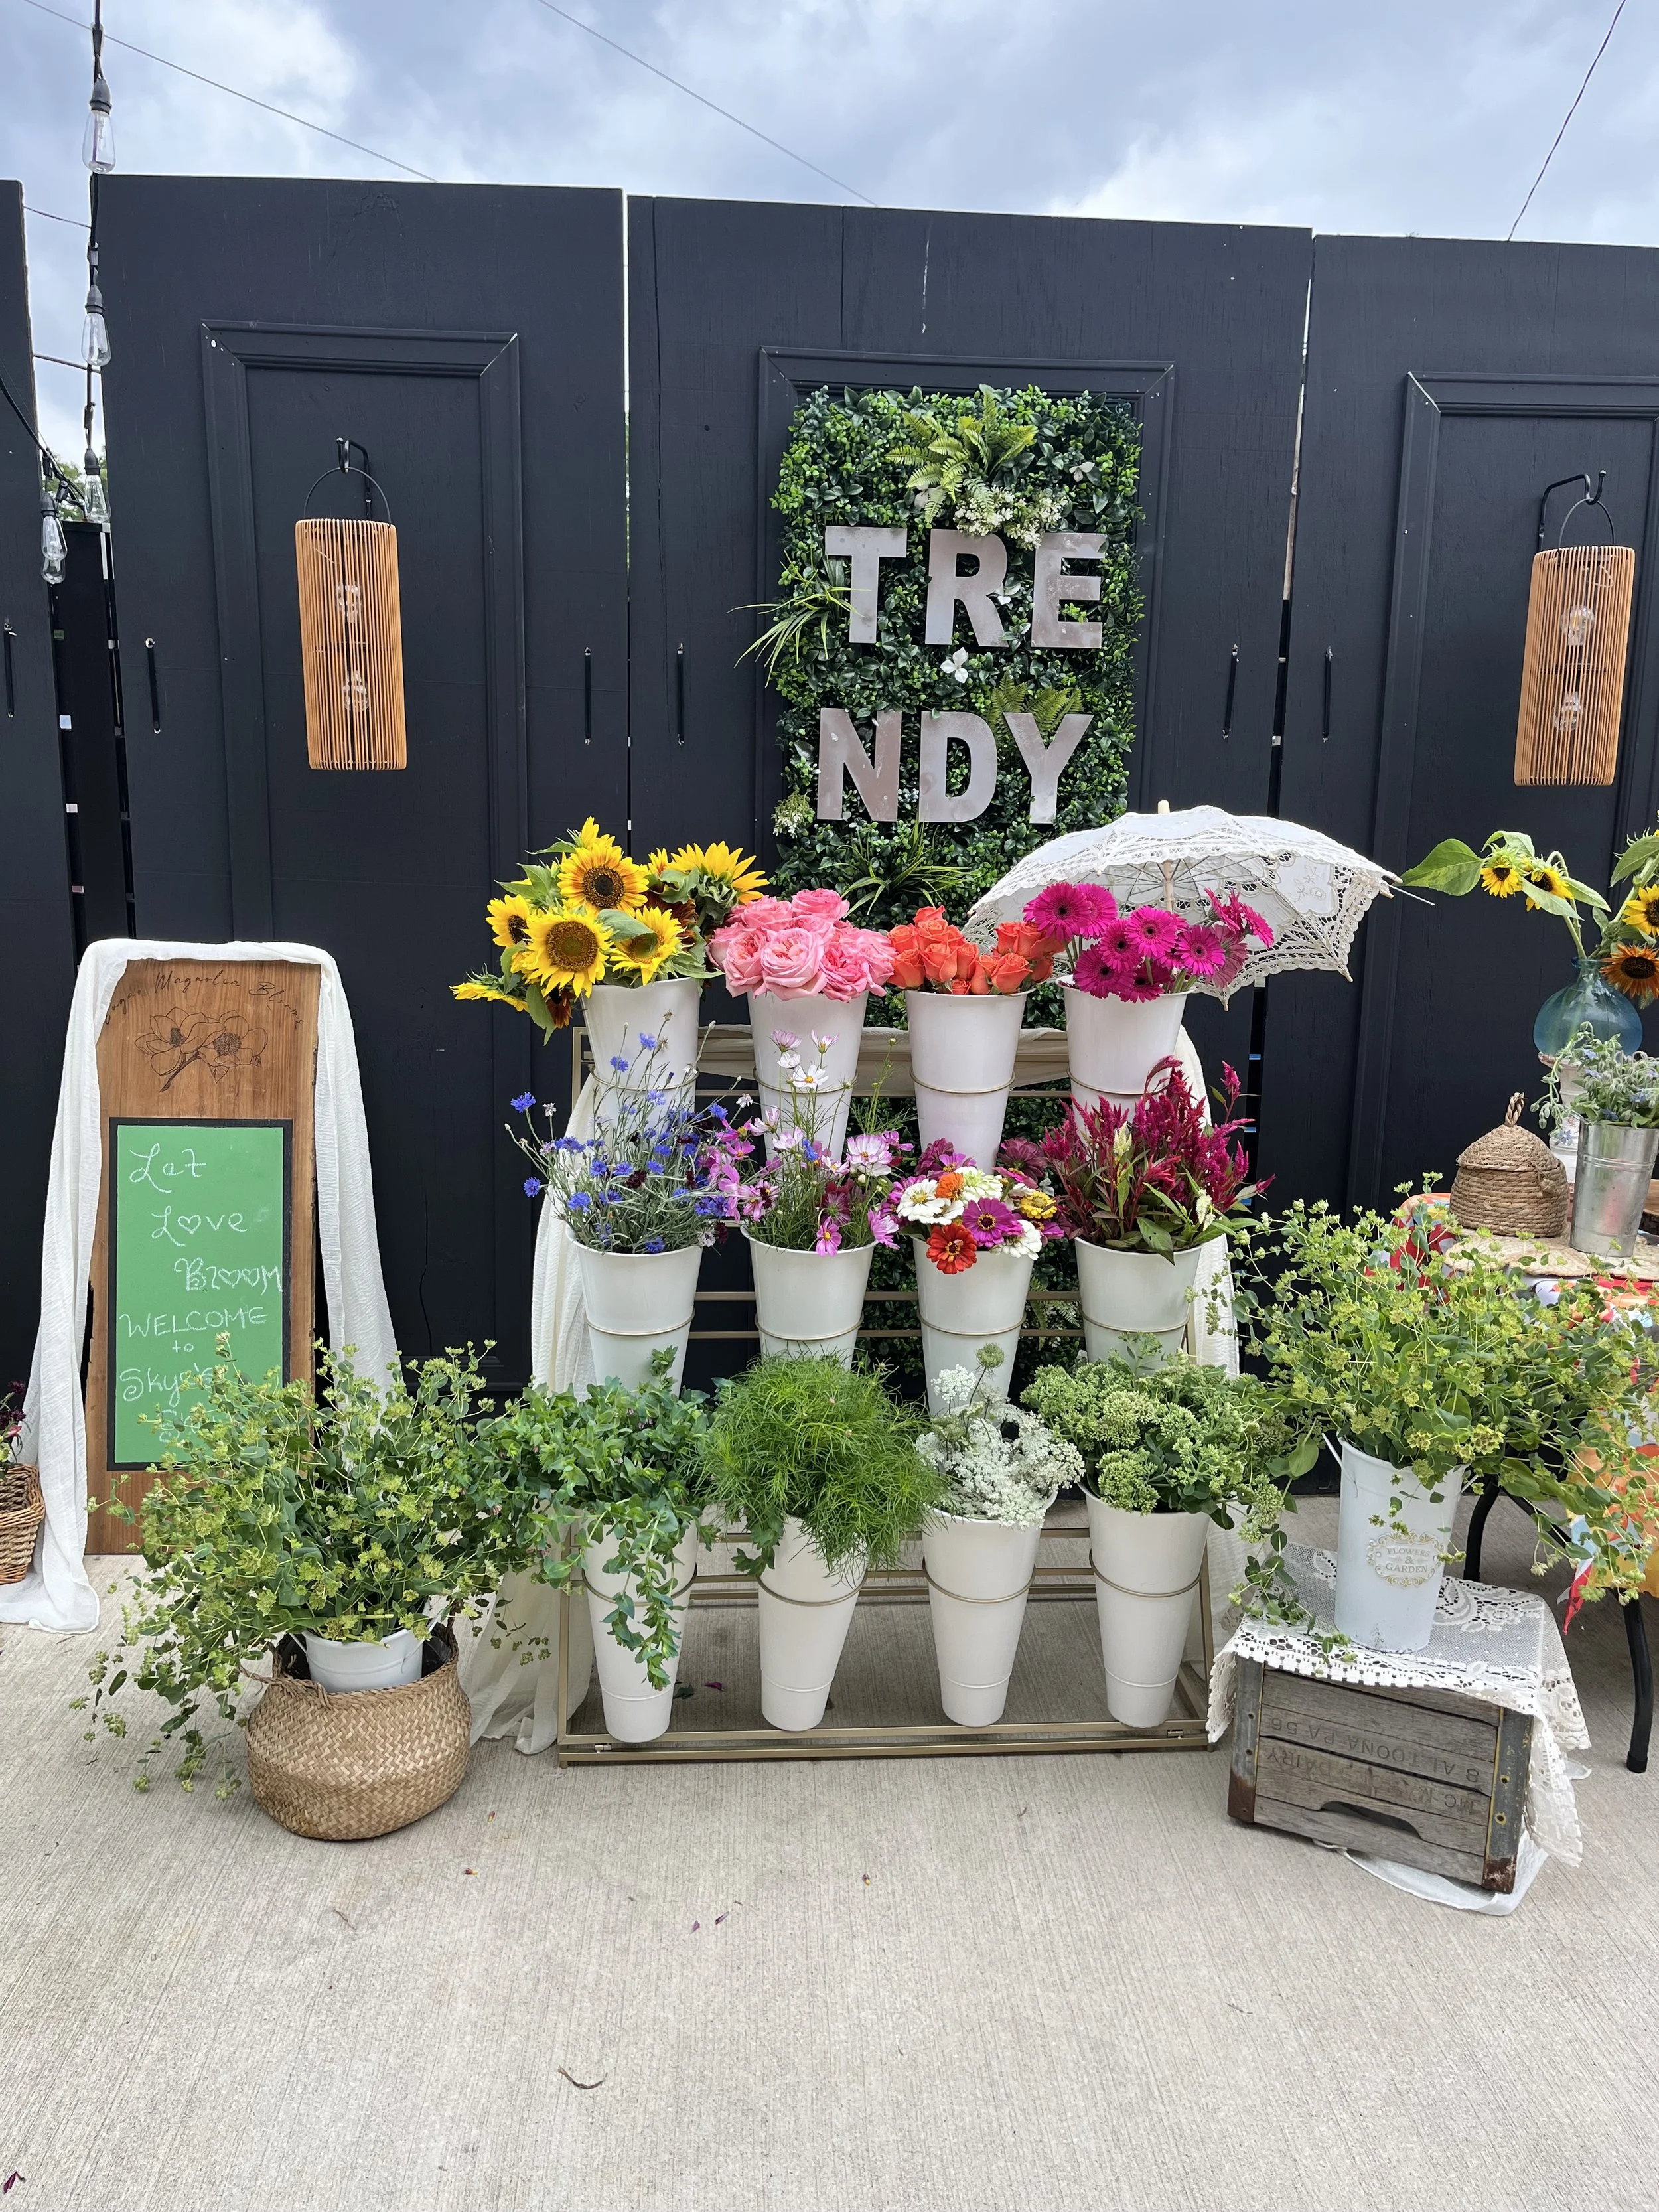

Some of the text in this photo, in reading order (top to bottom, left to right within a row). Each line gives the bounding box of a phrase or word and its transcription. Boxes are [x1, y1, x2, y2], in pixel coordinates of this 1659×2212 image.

[825, 525, 1107, 648] TRE
[817, 707, 1095, 824] NDY
[155, 969, 241, 994] Magnolia
[249, 981, 304, 1029] Blooms
[151, 1205, 248, 1247] Love
[119, 1306, 269, 1338] WELCOME
[171, 1339, 194, 1353] to
[1387, 1547, 1431, 1557] FLOWERS
[1404, 1555, 1415, 1564] &
[1386, 1562, 1429, 1573] GARDEN
[1271, 1717, 1298, 1737] 56
[1308, 1725, 1335, 1745] PA
[1267, 1747, 1331, 1777] DAIRY
